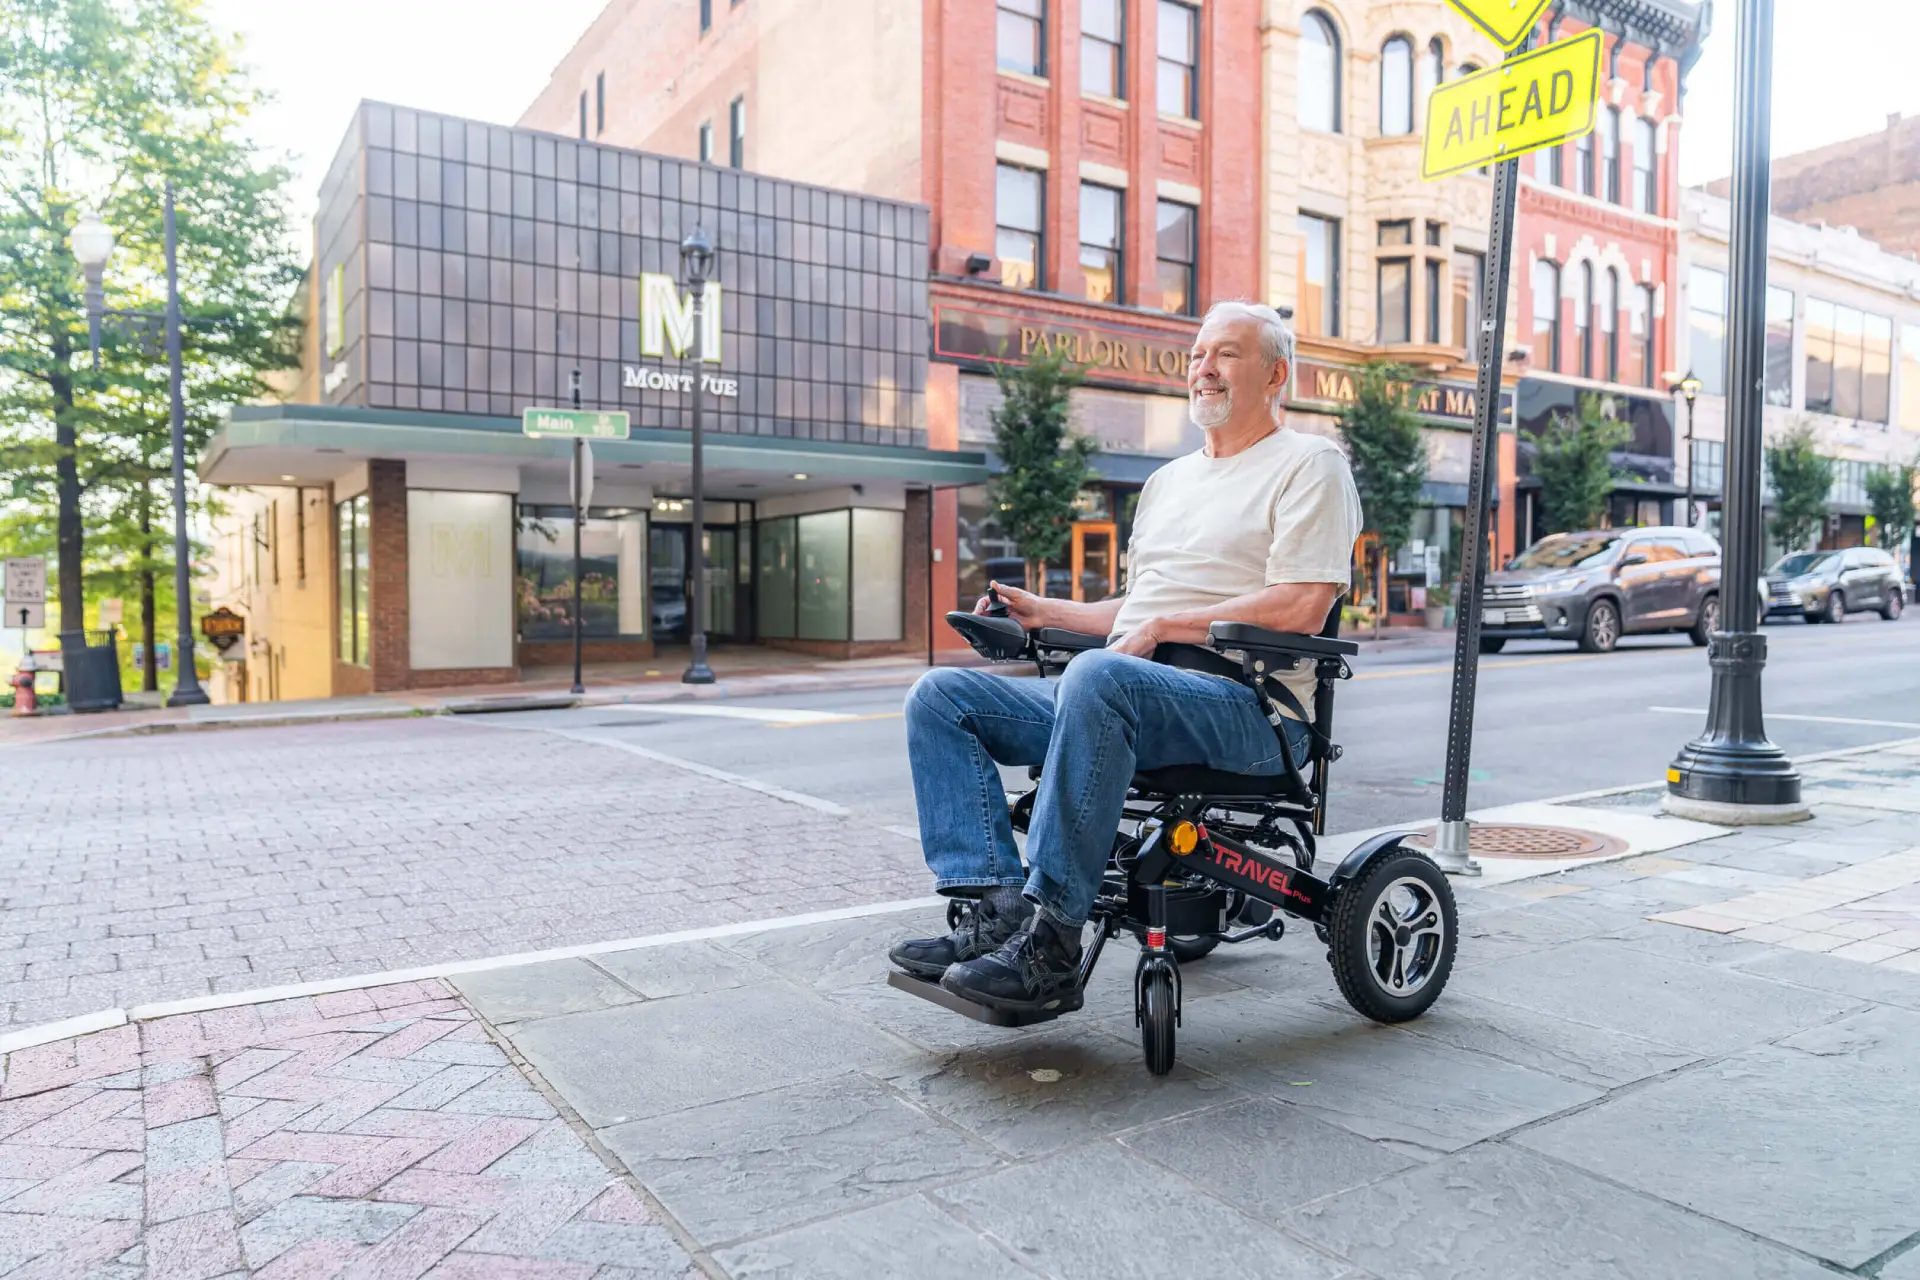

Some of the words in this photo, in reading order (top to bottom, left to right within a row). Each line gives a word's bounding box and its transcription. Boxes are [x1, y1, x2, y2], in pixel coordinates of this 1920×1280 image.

[1443, 69, 1573, 150] AHEAD
[640, 272, 721, 362] M
[1020, 327, 1129, 369] PARLOR
[1144, 345, 1192, 377] LOF
[1315, 369, 1413, 409] MAET
[1417, 390, 1440, 412] AT
[1445, 390, 1476, 416] MA
[537, 413, 574, 431] Main
[1205, 842, 1293, 895] TRAVEL
[1292, 889, 1312, 905] Plus
